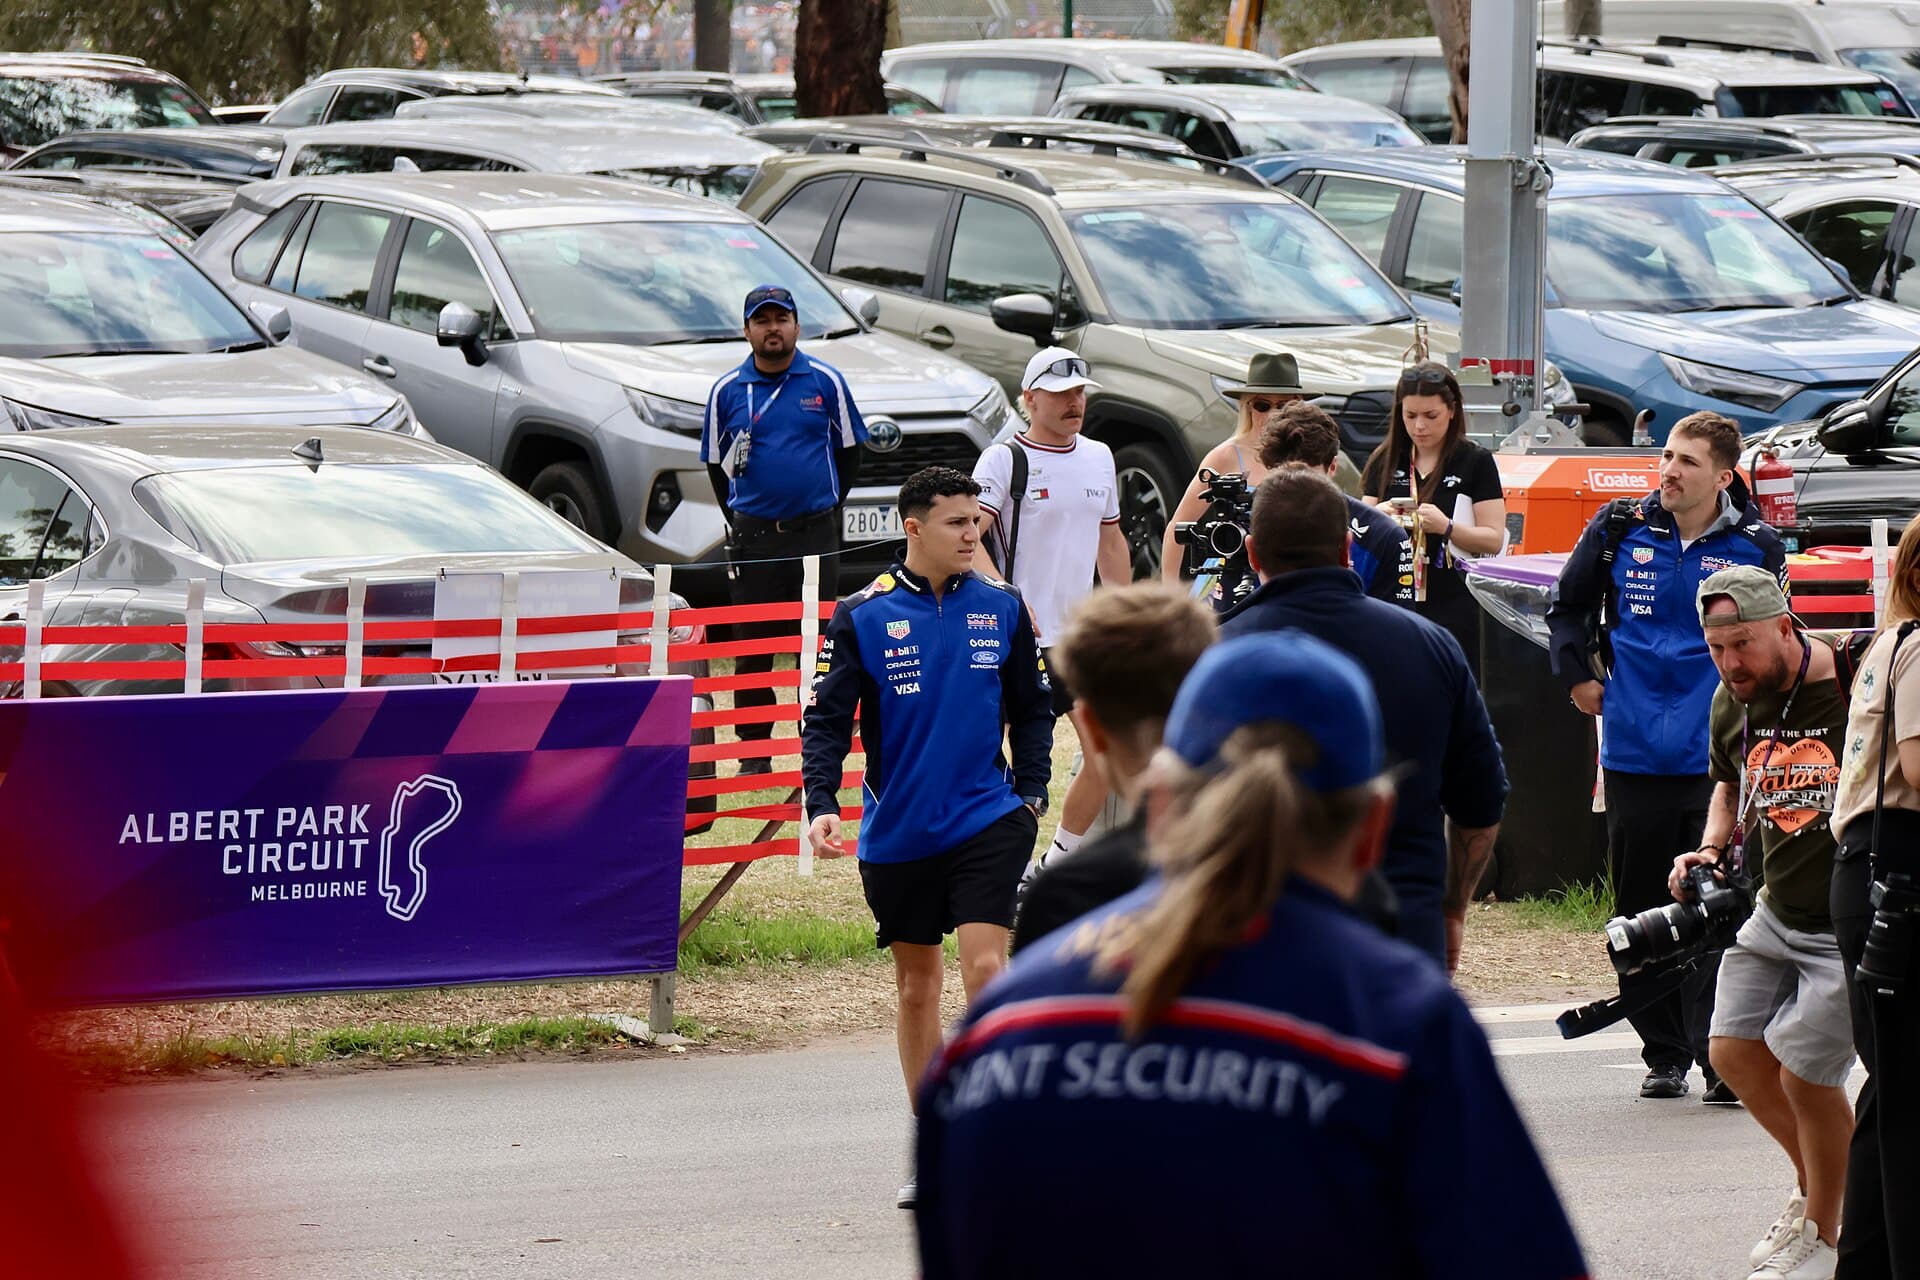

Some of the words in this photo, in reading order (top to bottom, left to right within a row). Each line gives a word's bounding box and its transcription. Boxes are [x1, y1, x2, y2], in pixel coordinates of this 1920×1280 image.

[1594, 472, 1648, 487] Coates
[1702, 556, 1732, 565] ORACLE
[1626, 570, 1648, 579] Mobil
[1625, 593, 1655, 601] CARLYLE
[1630, 603, 1652, 615] VISA
[885, 647, 909, 658] Mobil
[886, 659, 920, 669] ORACLE
[888, 671, 921, 680] CARLYLE
[893, 682, 920, 695] VISA
[1781, 730, 1800, 738] THE
[1805, 728, 1828, 737] BEST
[1790, 743, 1828, 760] DETROIT
[1746, 763, 1840, 795] Palace
[119, 808, 265, 844] ALBERT
[276, 804, 371, 837] PARK
[222, 838, 369, 874] CIRCUIT
[251, 880, 367, 902] MELBOURNE
[1059, 1041, 1347, 1126] SECURITY
